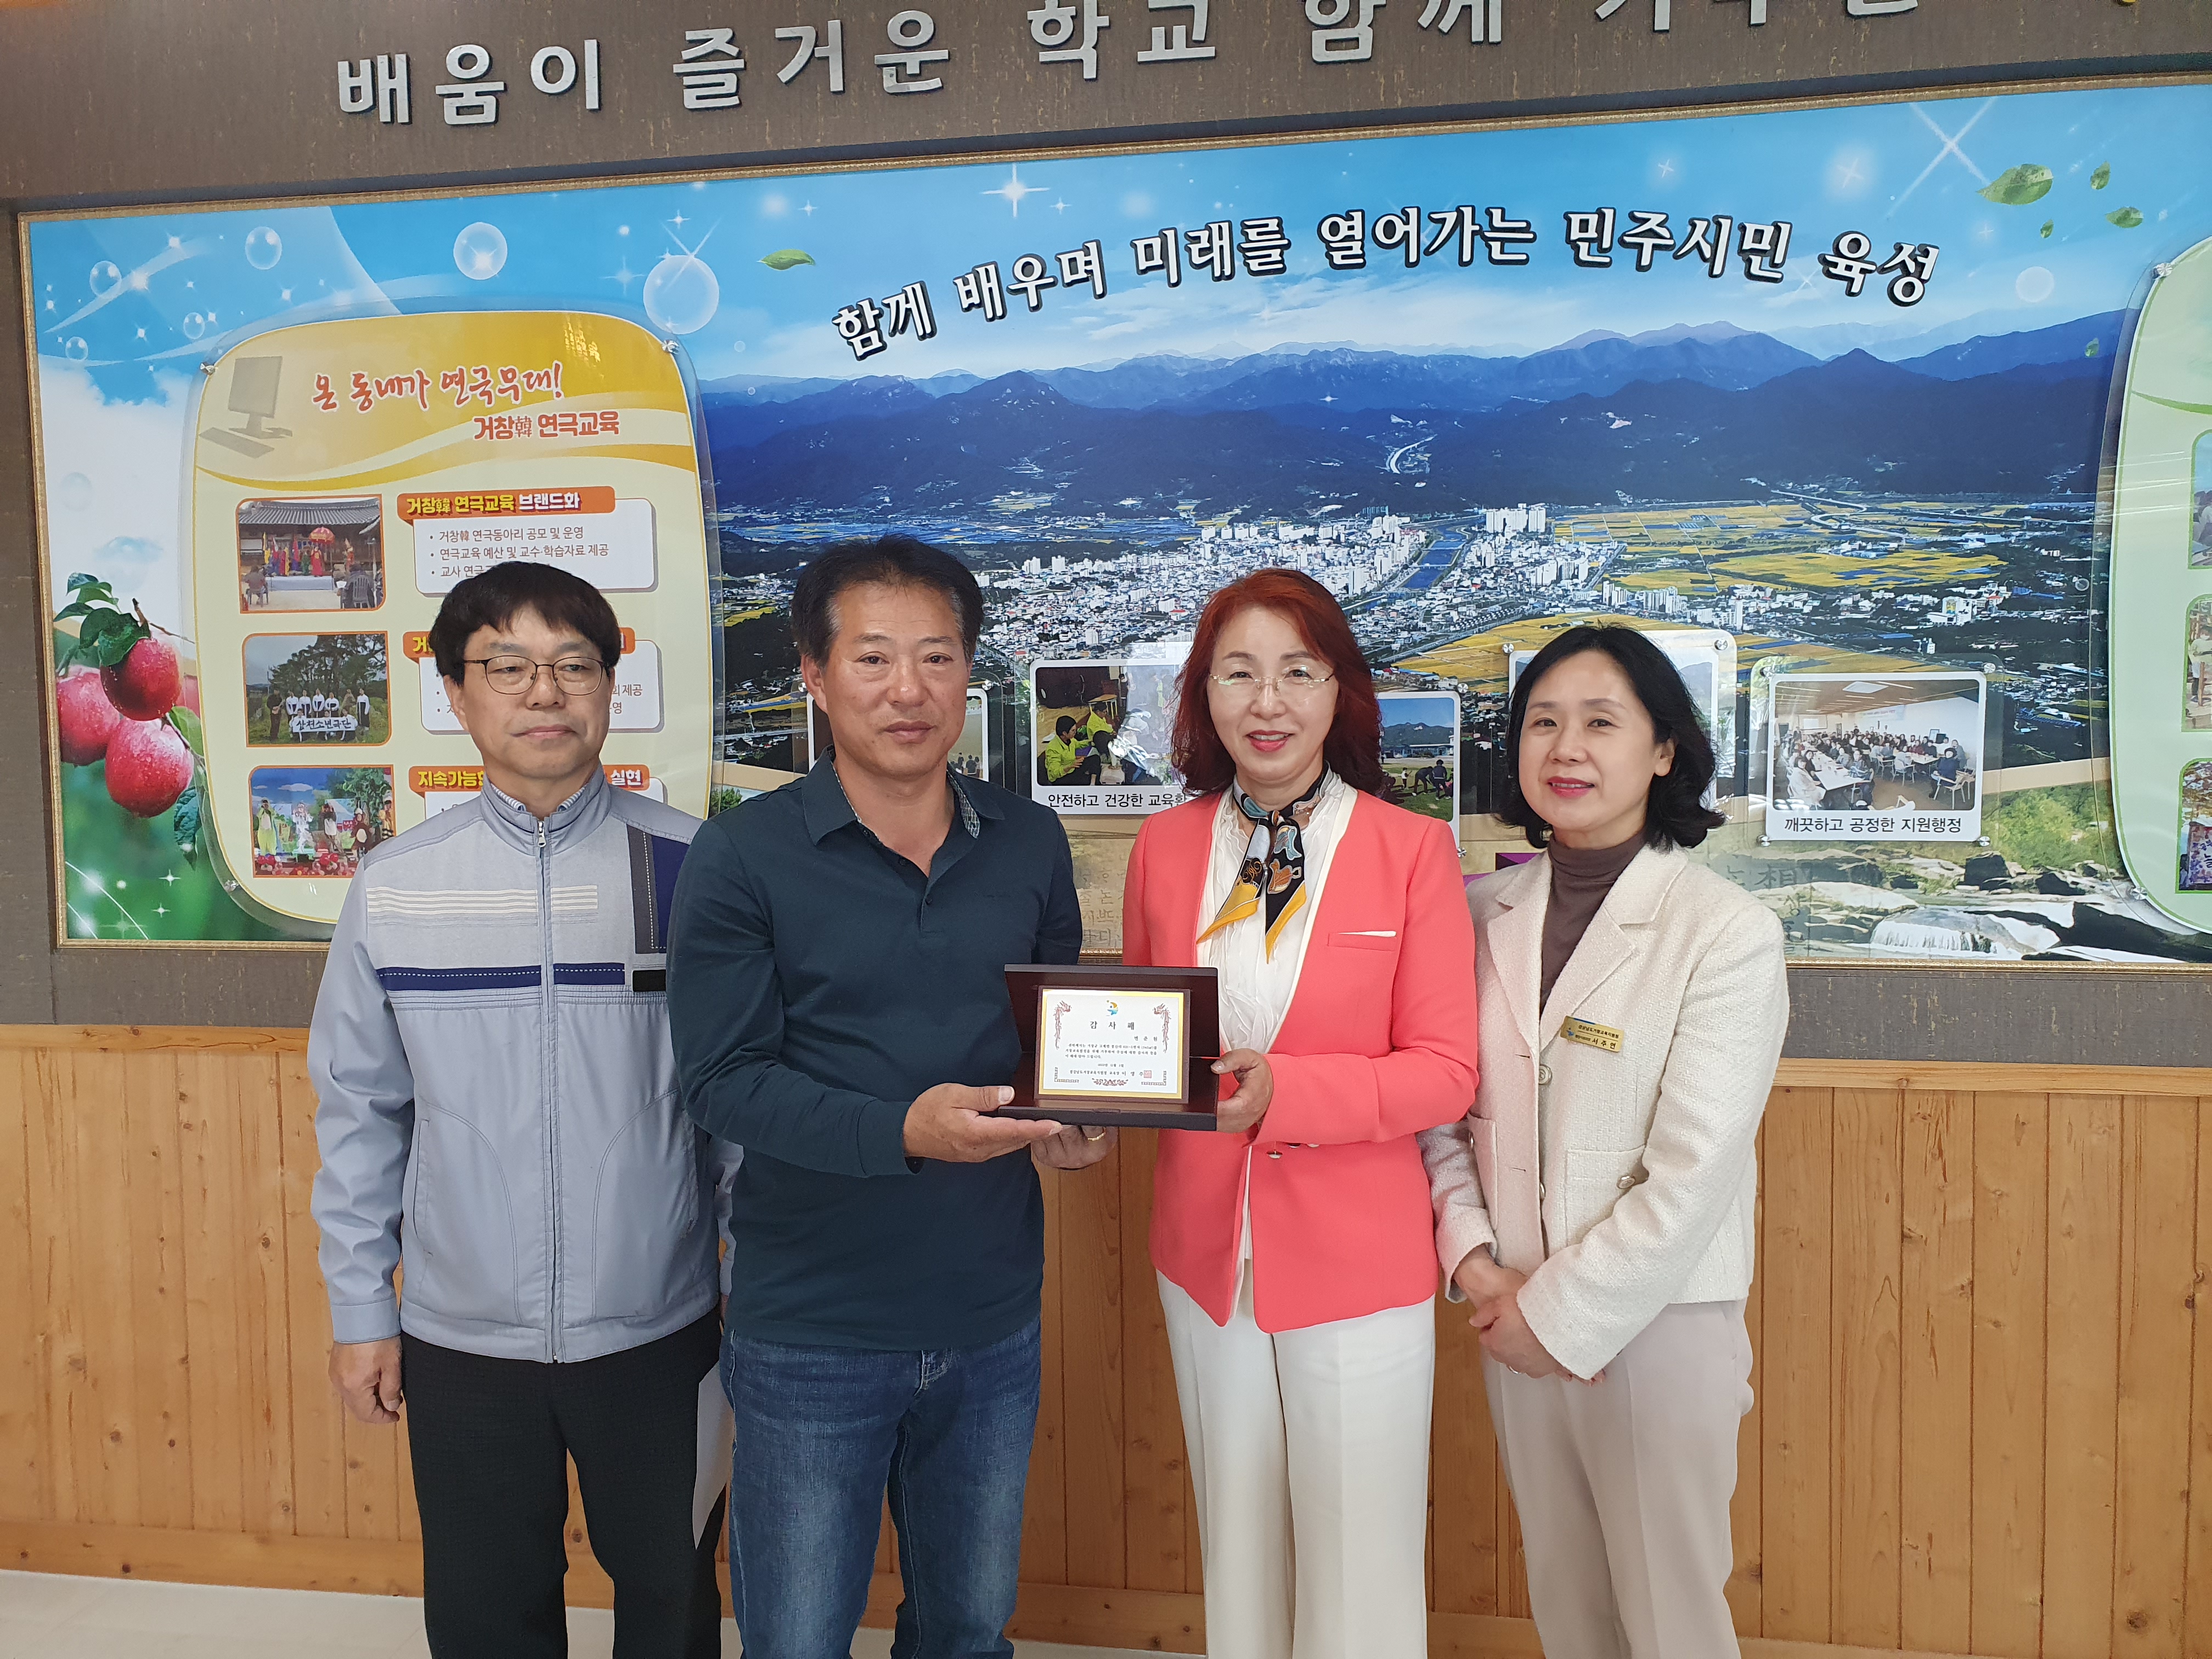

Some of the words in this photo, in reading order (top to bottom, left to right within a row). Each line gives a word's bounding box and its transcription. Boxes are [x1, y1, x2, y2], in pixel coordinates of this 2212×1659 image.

[337, 39, 600, 125] 배움이
[672, 9, 949, 110] 즐거운
[1026, 0, 1216, 80] 학교
[832, 280, 937, 361] 함께
[953, 239, 1107, 323] 배우며
[1130, 216, 1291, 287] 미래를
[1317, 206, 1536, 269] 열어가는
[1564, 207, 1793, 283] 민주시민
[1819, 230, 1940, 307] 육성
[312, 374, 337, 410] 온
[441, 362, 561, 405] 연극무대!
[474, 415, 532, 439] 거창韓
[538, 411, 620, 437] 연극교육
[407, 497, 451, 514] 거창韓
[455, 495, 515, 512] 연극교육
[519, 493, 580, 510] 브랜드화
[472, 528, 523, 541] 연극동아리
[526, 528, 548, 540] 공모
[550, 527, 560, 539] 및
[563, 527, 583, 539] 운영
[440, 548, 481, 560] 연극교육
[484, 546, 504, 559] 예산
[506, 546, 517, 558] 및
[588, 544, 609, 556] 제공
[441, 566, 460, 578] 교사
[464, 565, 493, 577] 연극
[413, 636, 433, 652] 거
[622, 684, 642, 696] 제공
[610, 702, 622, 714] 영
[611, 770, 642, 786] 실현
[1048, 794, 1099, 808] 안전하고
[1104, 793, 1143, 807] 건강한
[1785, 817, 1844, 832] 깨끗하고
[1849, 817, 1895, 832] 공정한
[1901, 817, 1961, 833] 지원행정
